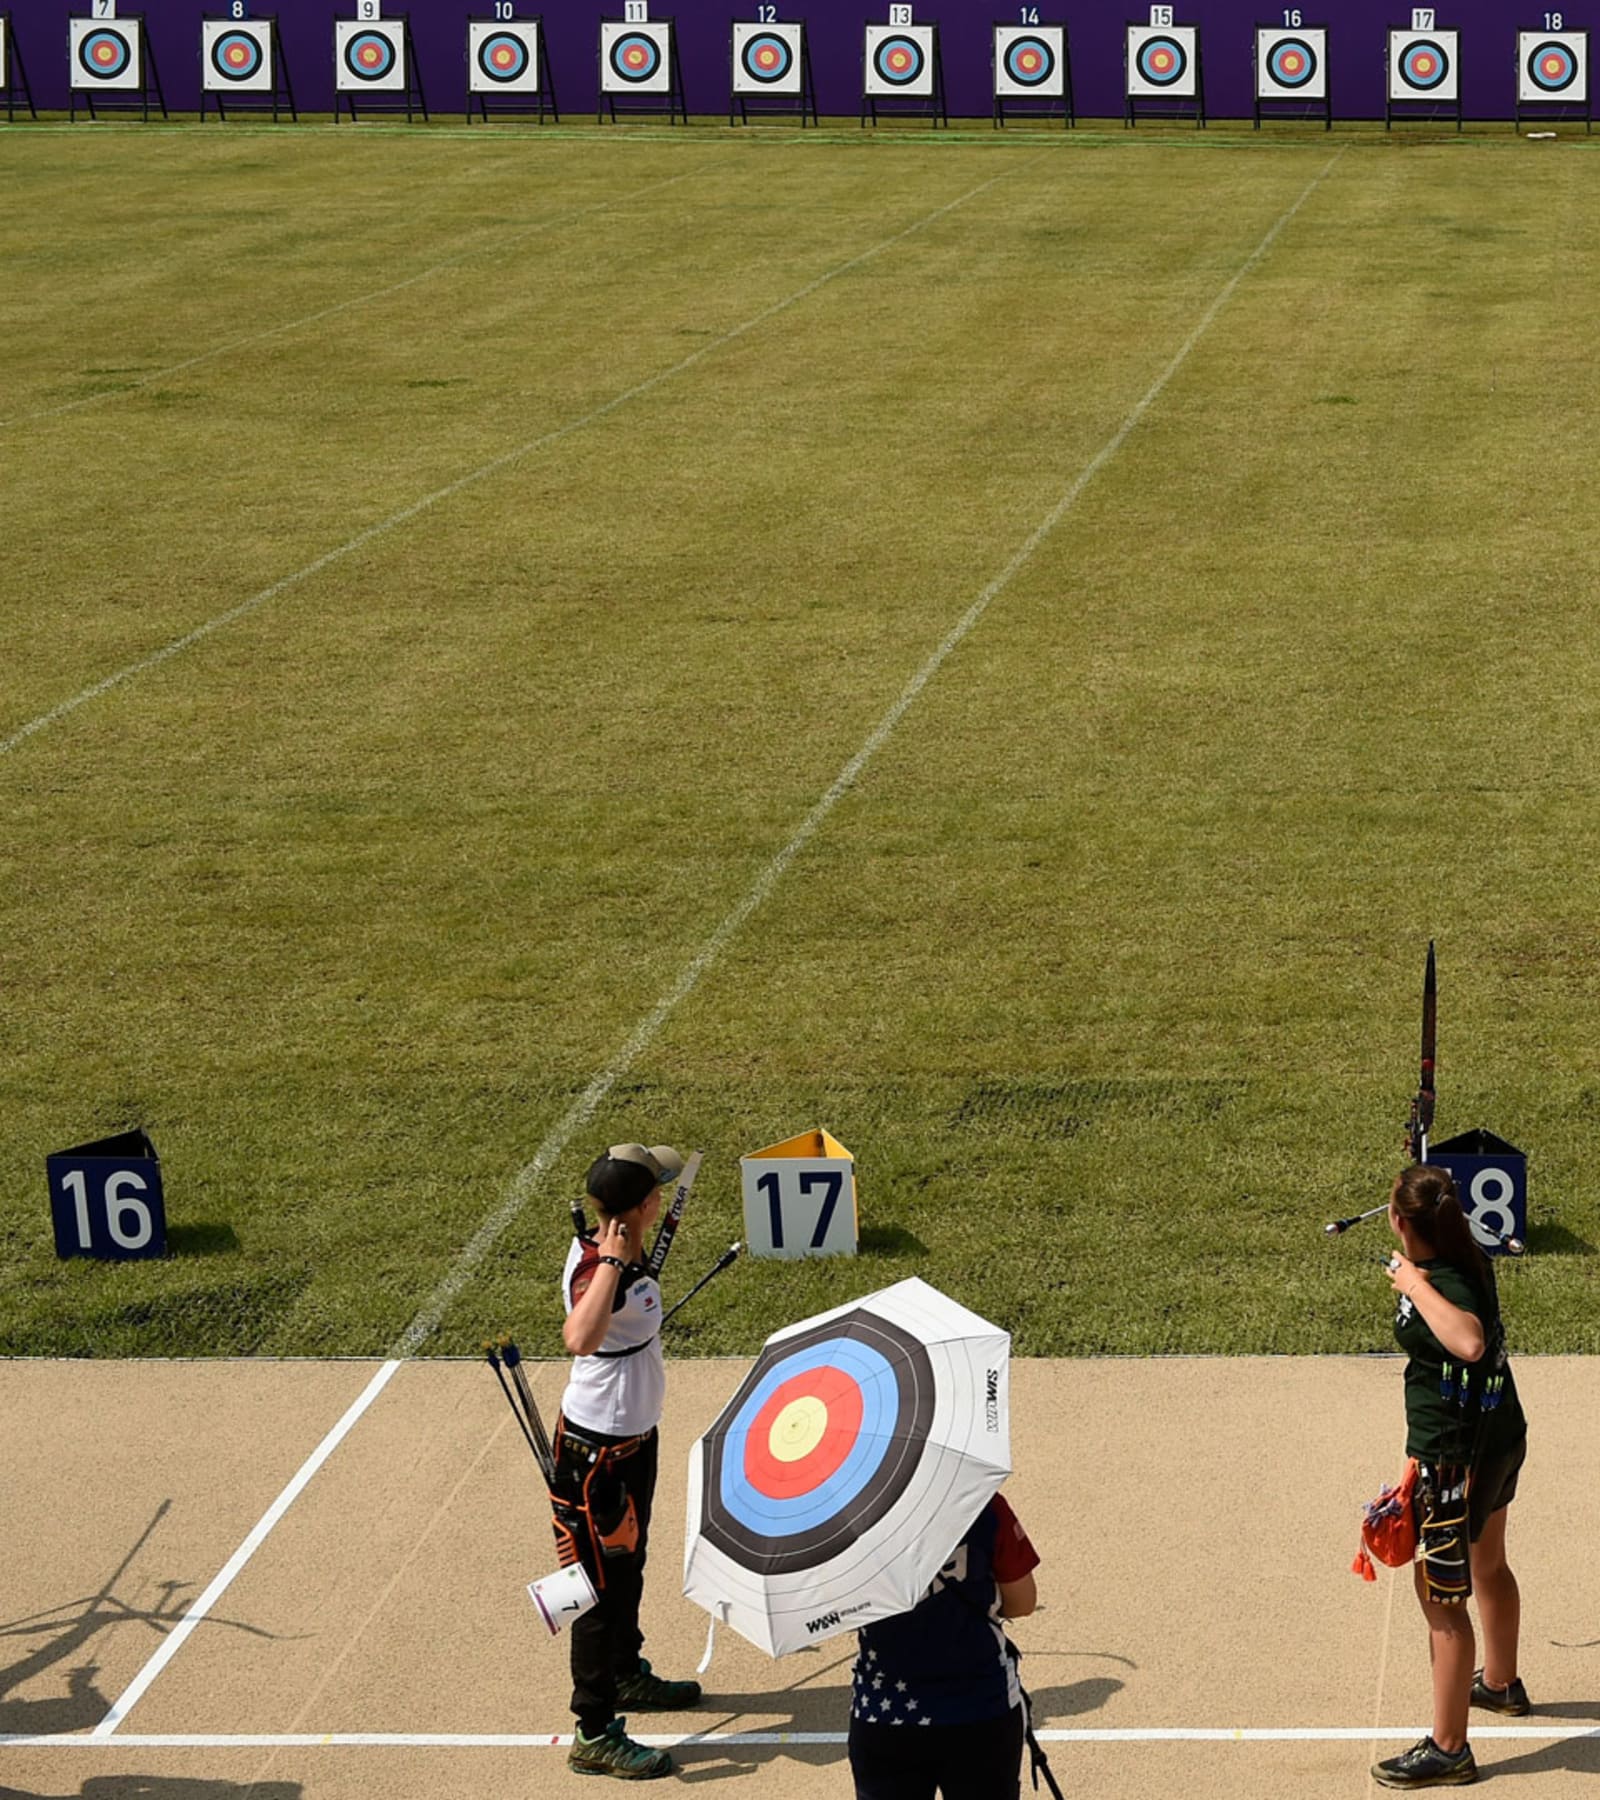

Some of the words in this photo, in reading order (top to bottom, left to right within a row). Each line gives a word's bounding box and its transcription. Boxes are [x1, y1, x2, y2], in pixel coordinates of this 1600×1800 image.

[99, 0, 108, 15] 7
[232, 1, 243, 17] 8
[364, 2, 374, 17] 9
[494, 2, 513, 20] 10
[628, 3, 644, 20] 11
[758, 5, 776, 23] 12
[892, 7, 910, 24] 13
[1020, 7, 1039, 25] 14
[1153, 7, 1171, 25] 15
[1283, 10, 1301, 27] 16
[1415, 11, 1432, 29] 17
[1544, 13, 1562, 30] 18
[61, 1170, 153, 1249] 16
[757, 1171, 843, 1249] 17
[1445, 1167, 1516, 1247] 8
[650, 1228, 672, 1270] HOYT
[805, 1610, 841, 1635] W&W
